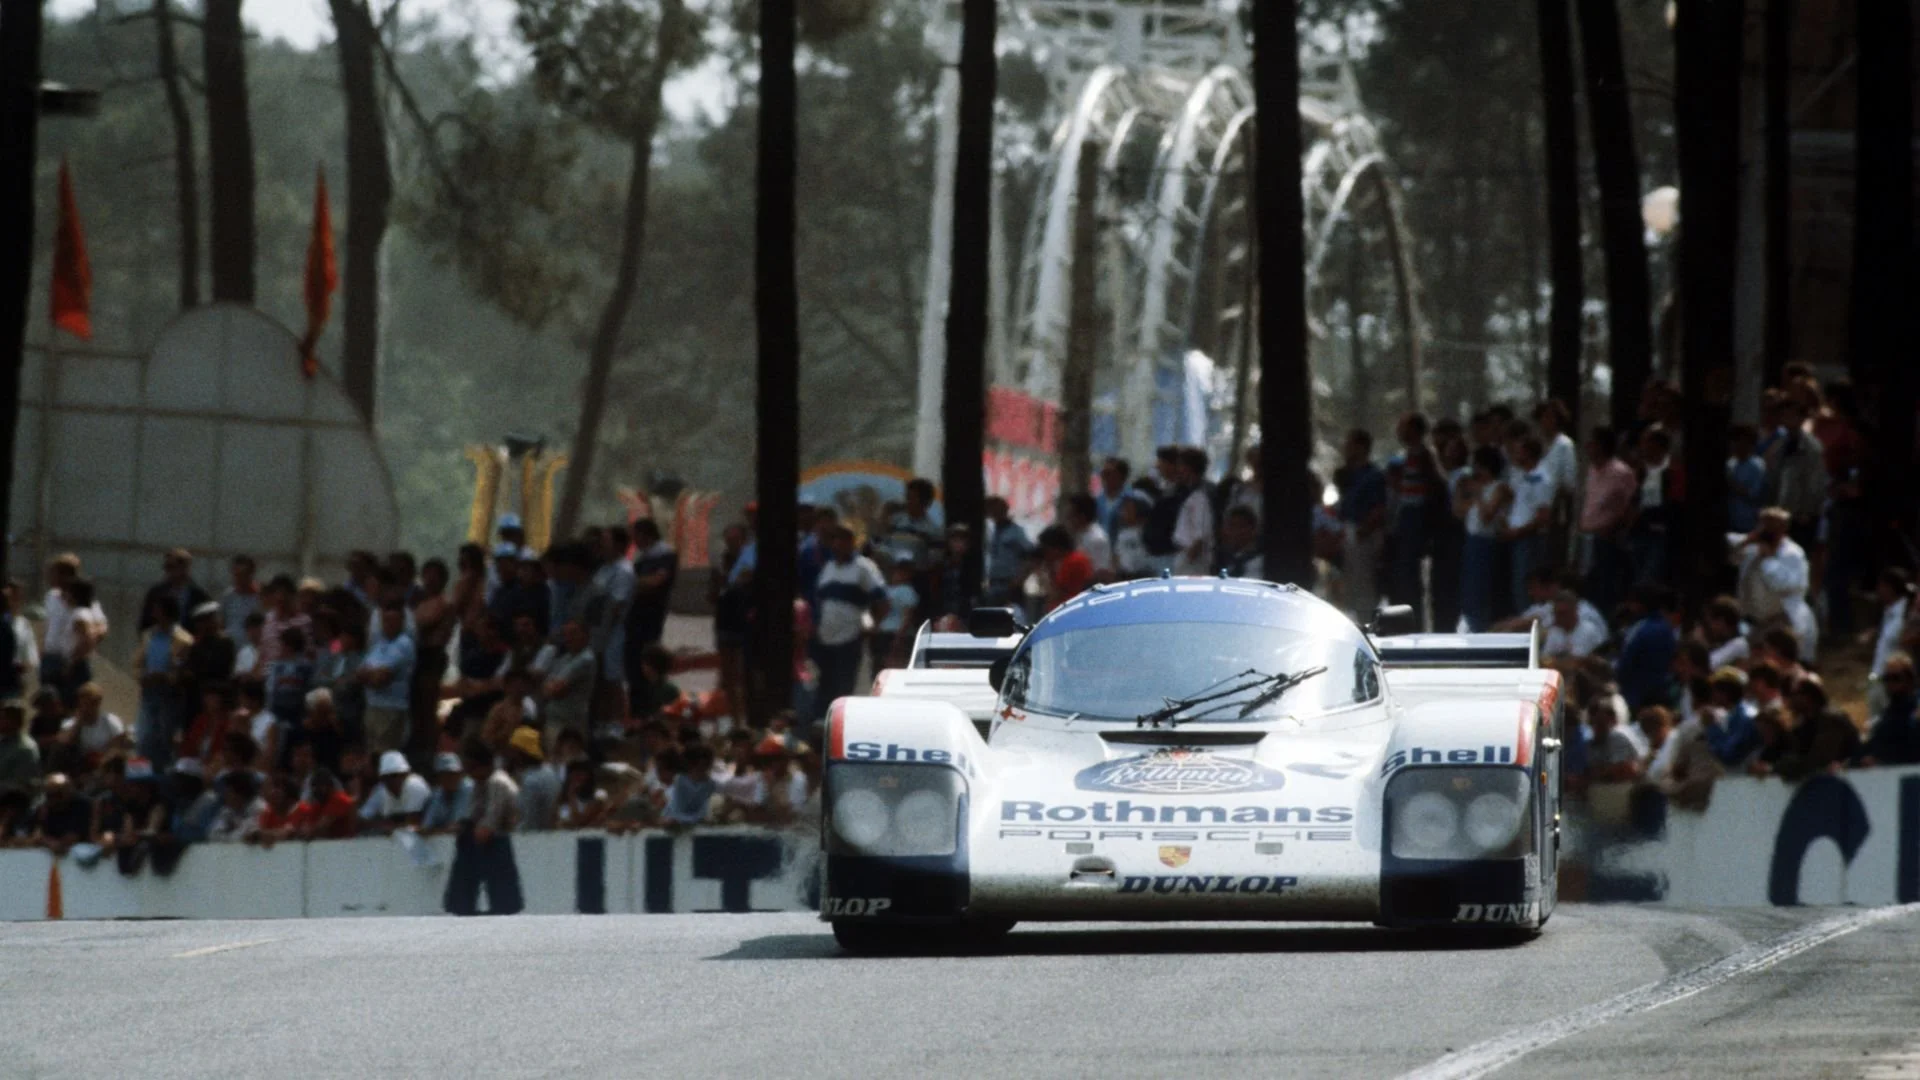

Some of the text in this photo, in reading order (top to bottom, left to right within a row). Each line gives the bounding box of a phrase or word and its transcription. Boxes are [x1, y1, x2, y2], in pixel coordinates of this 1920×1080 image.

[1381, 745, 1510, 778] Shell
[1000, 800, 1353, 823] Rothmans
[999, 830, 1353, 841] PORSCHE
[1117, 875, 1298, 896] DUNLOP
